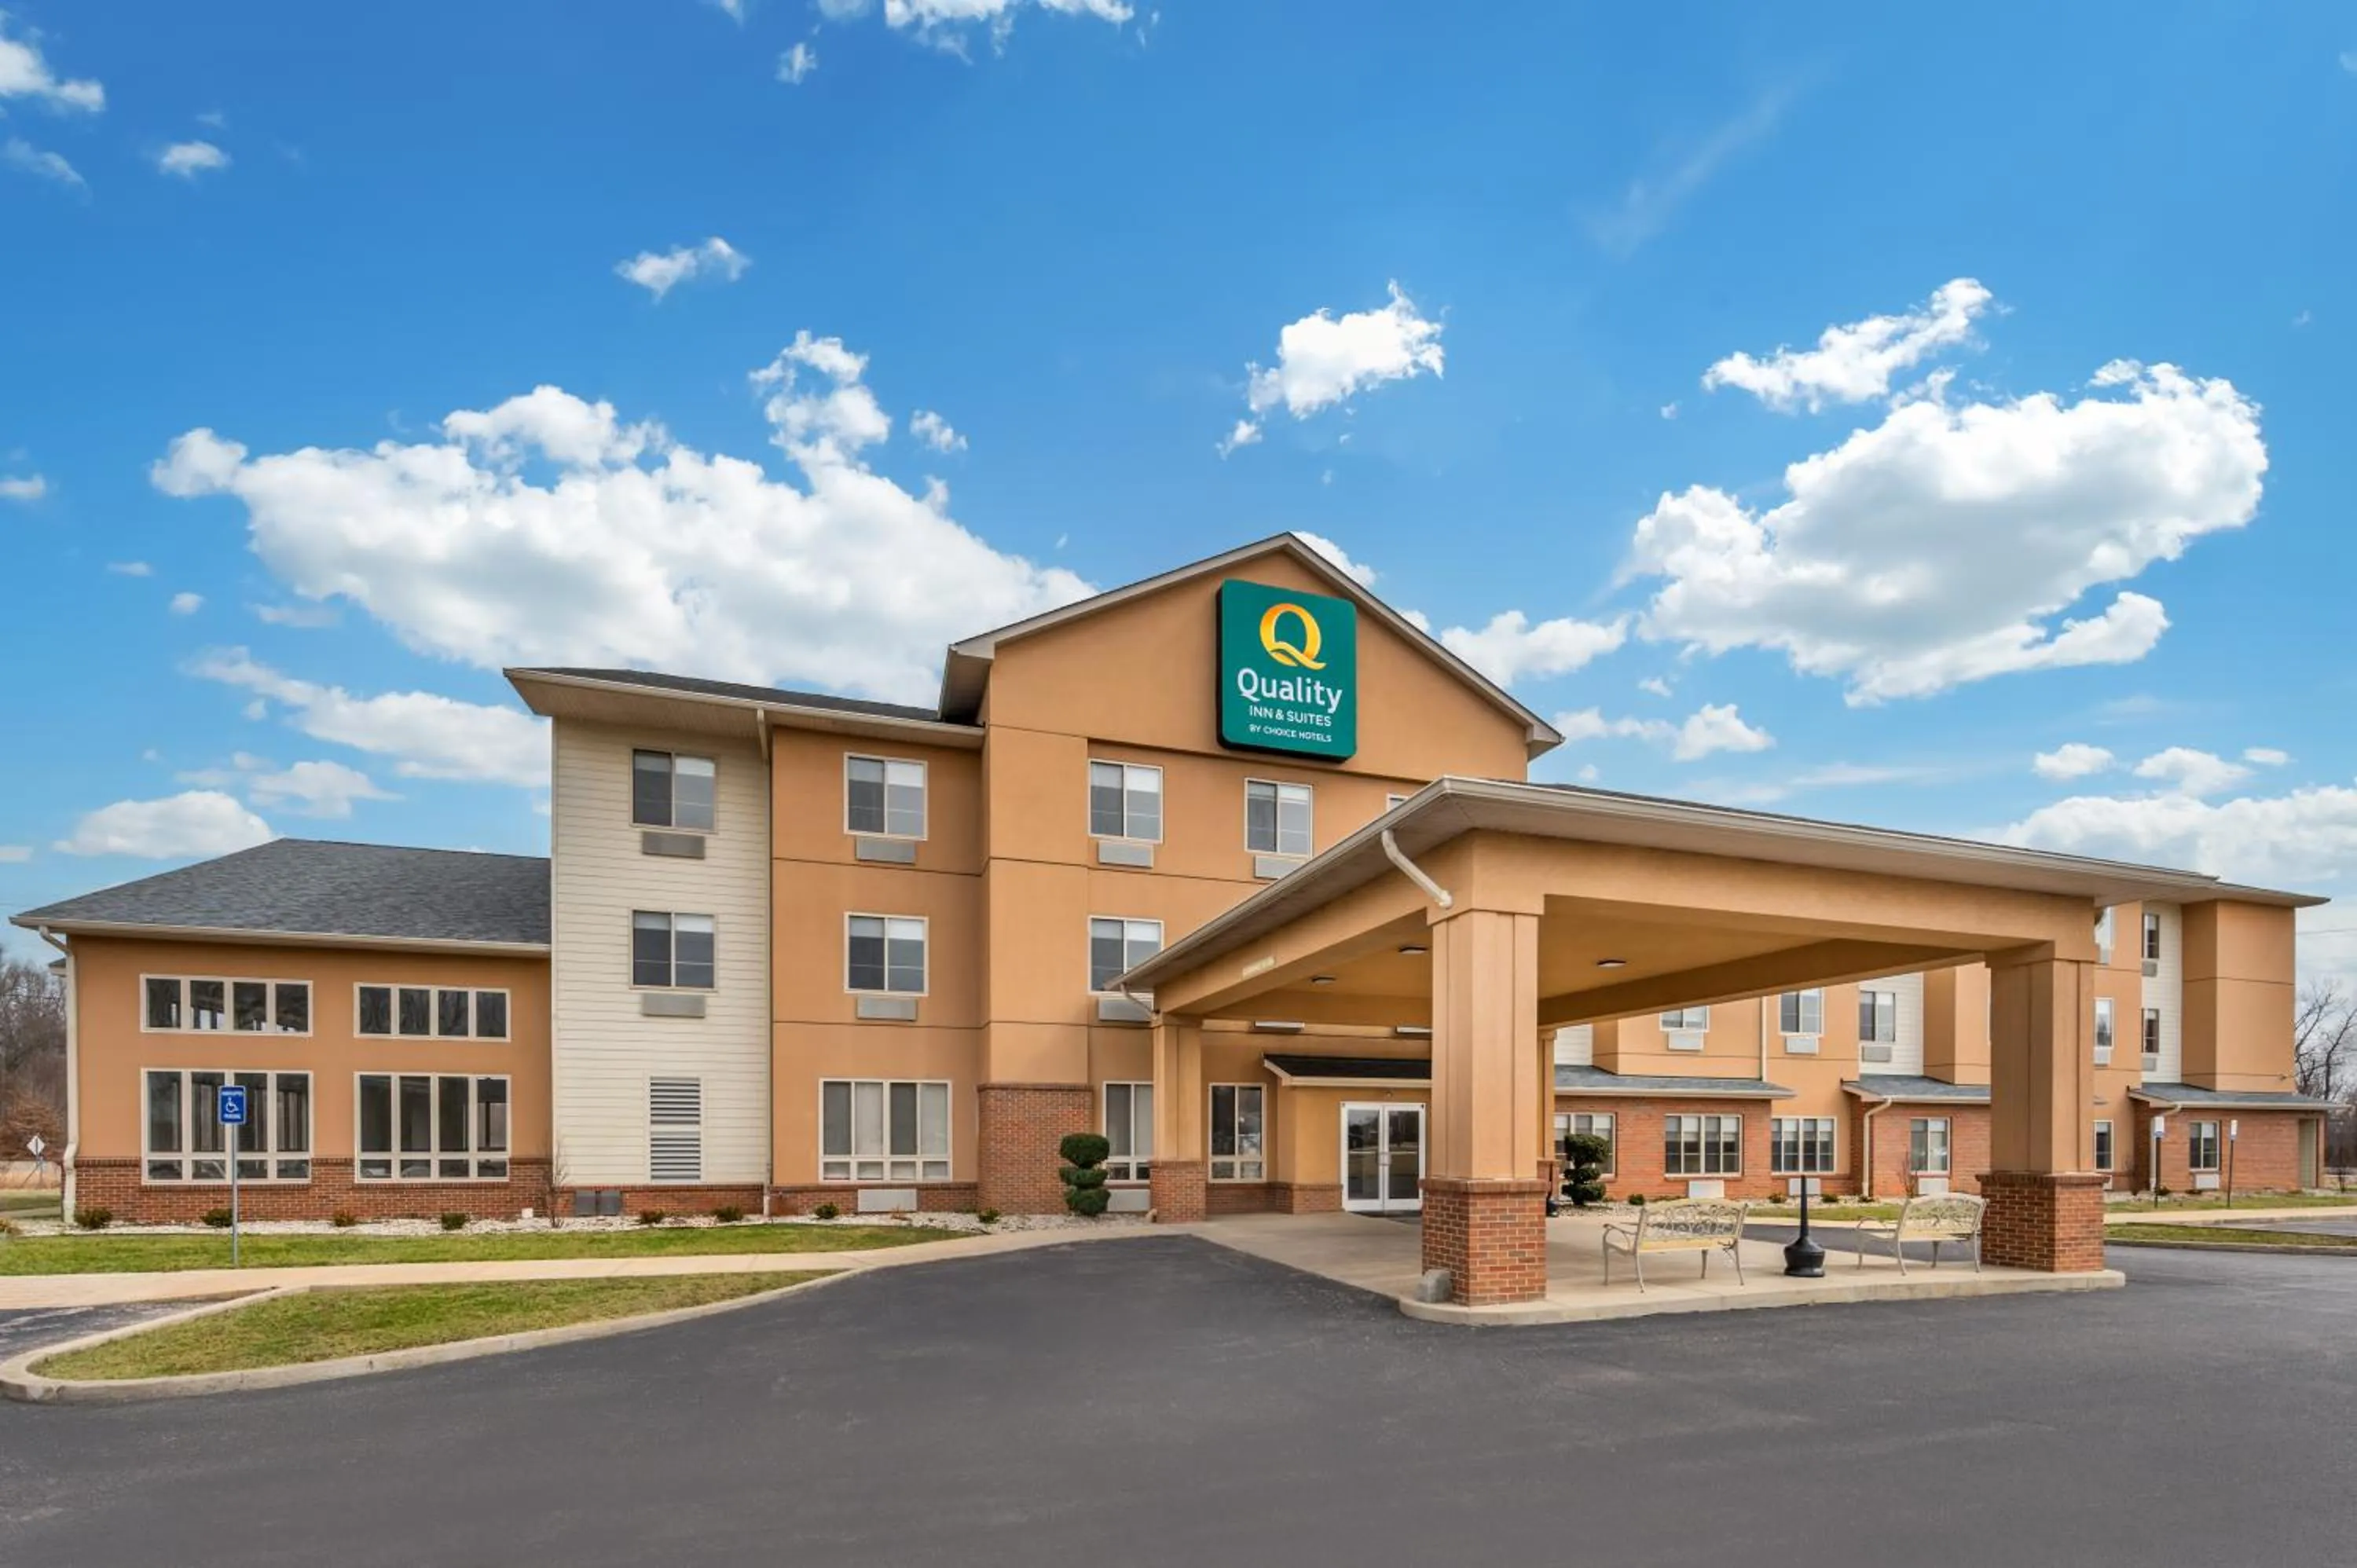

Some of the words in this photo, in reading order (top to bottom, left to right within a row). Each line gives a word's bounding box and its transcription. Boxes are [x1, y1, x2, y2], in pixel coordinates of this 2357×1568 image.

[1259, 603, 1326, 670] Q
[1237, 667, 1343, 714] Quality
[1249, 705, 1273, 719] INN
[1275, 709, 1284, 720] &
[1286, 710, 1332, 727] SUITES
[1249, 724, 1261, 732] BY
[1263, 725, 1296, 738] CHOICE
[1299, 731, 1332, 742] HOTELS
